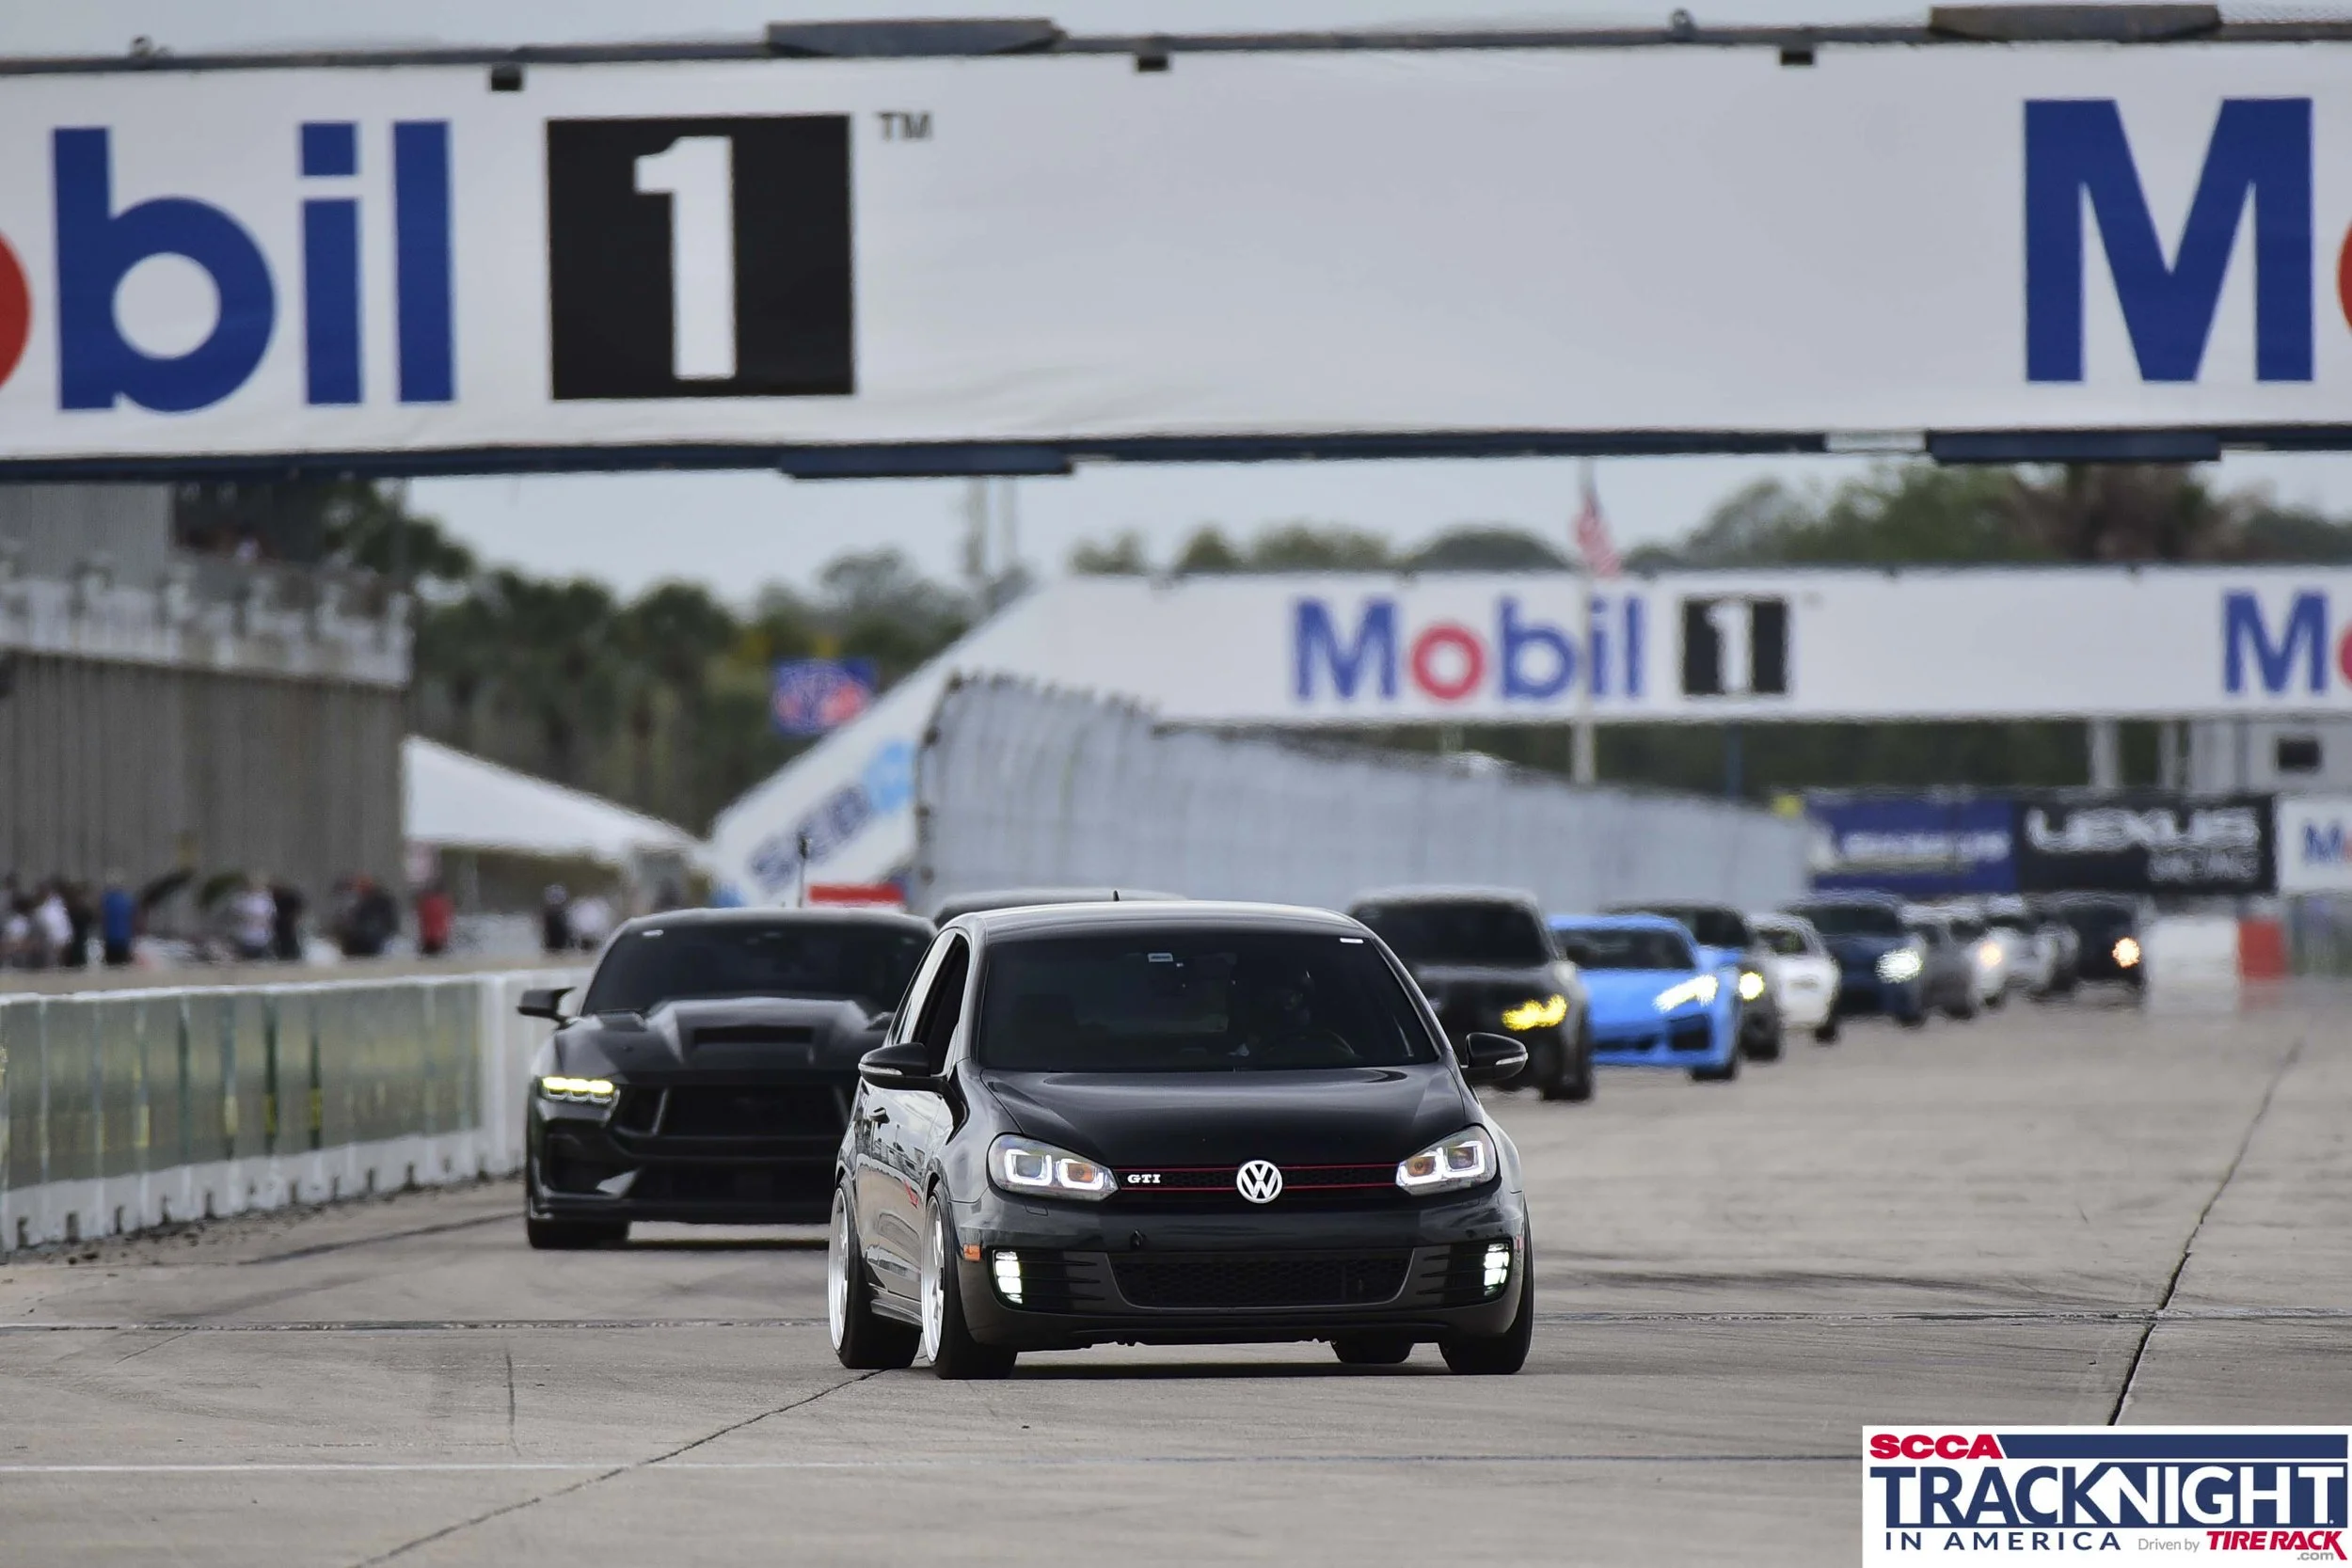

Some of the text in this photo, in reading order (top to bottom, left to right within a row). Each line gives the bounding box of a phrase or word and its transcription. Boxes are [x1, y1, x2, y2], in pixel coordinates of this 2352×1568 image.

[877, 111, 931, 141] TM
[0, 120, 737, 413] bil 1
[2024, 97, 2352, 382] M
[1294, 594, 1752, 702] Mobil 1
[2222, 590, 2352, 695] M
[2025, 807, 2258, 850] LEXUS
[1127, 1174, 1161, 1184] GTI
